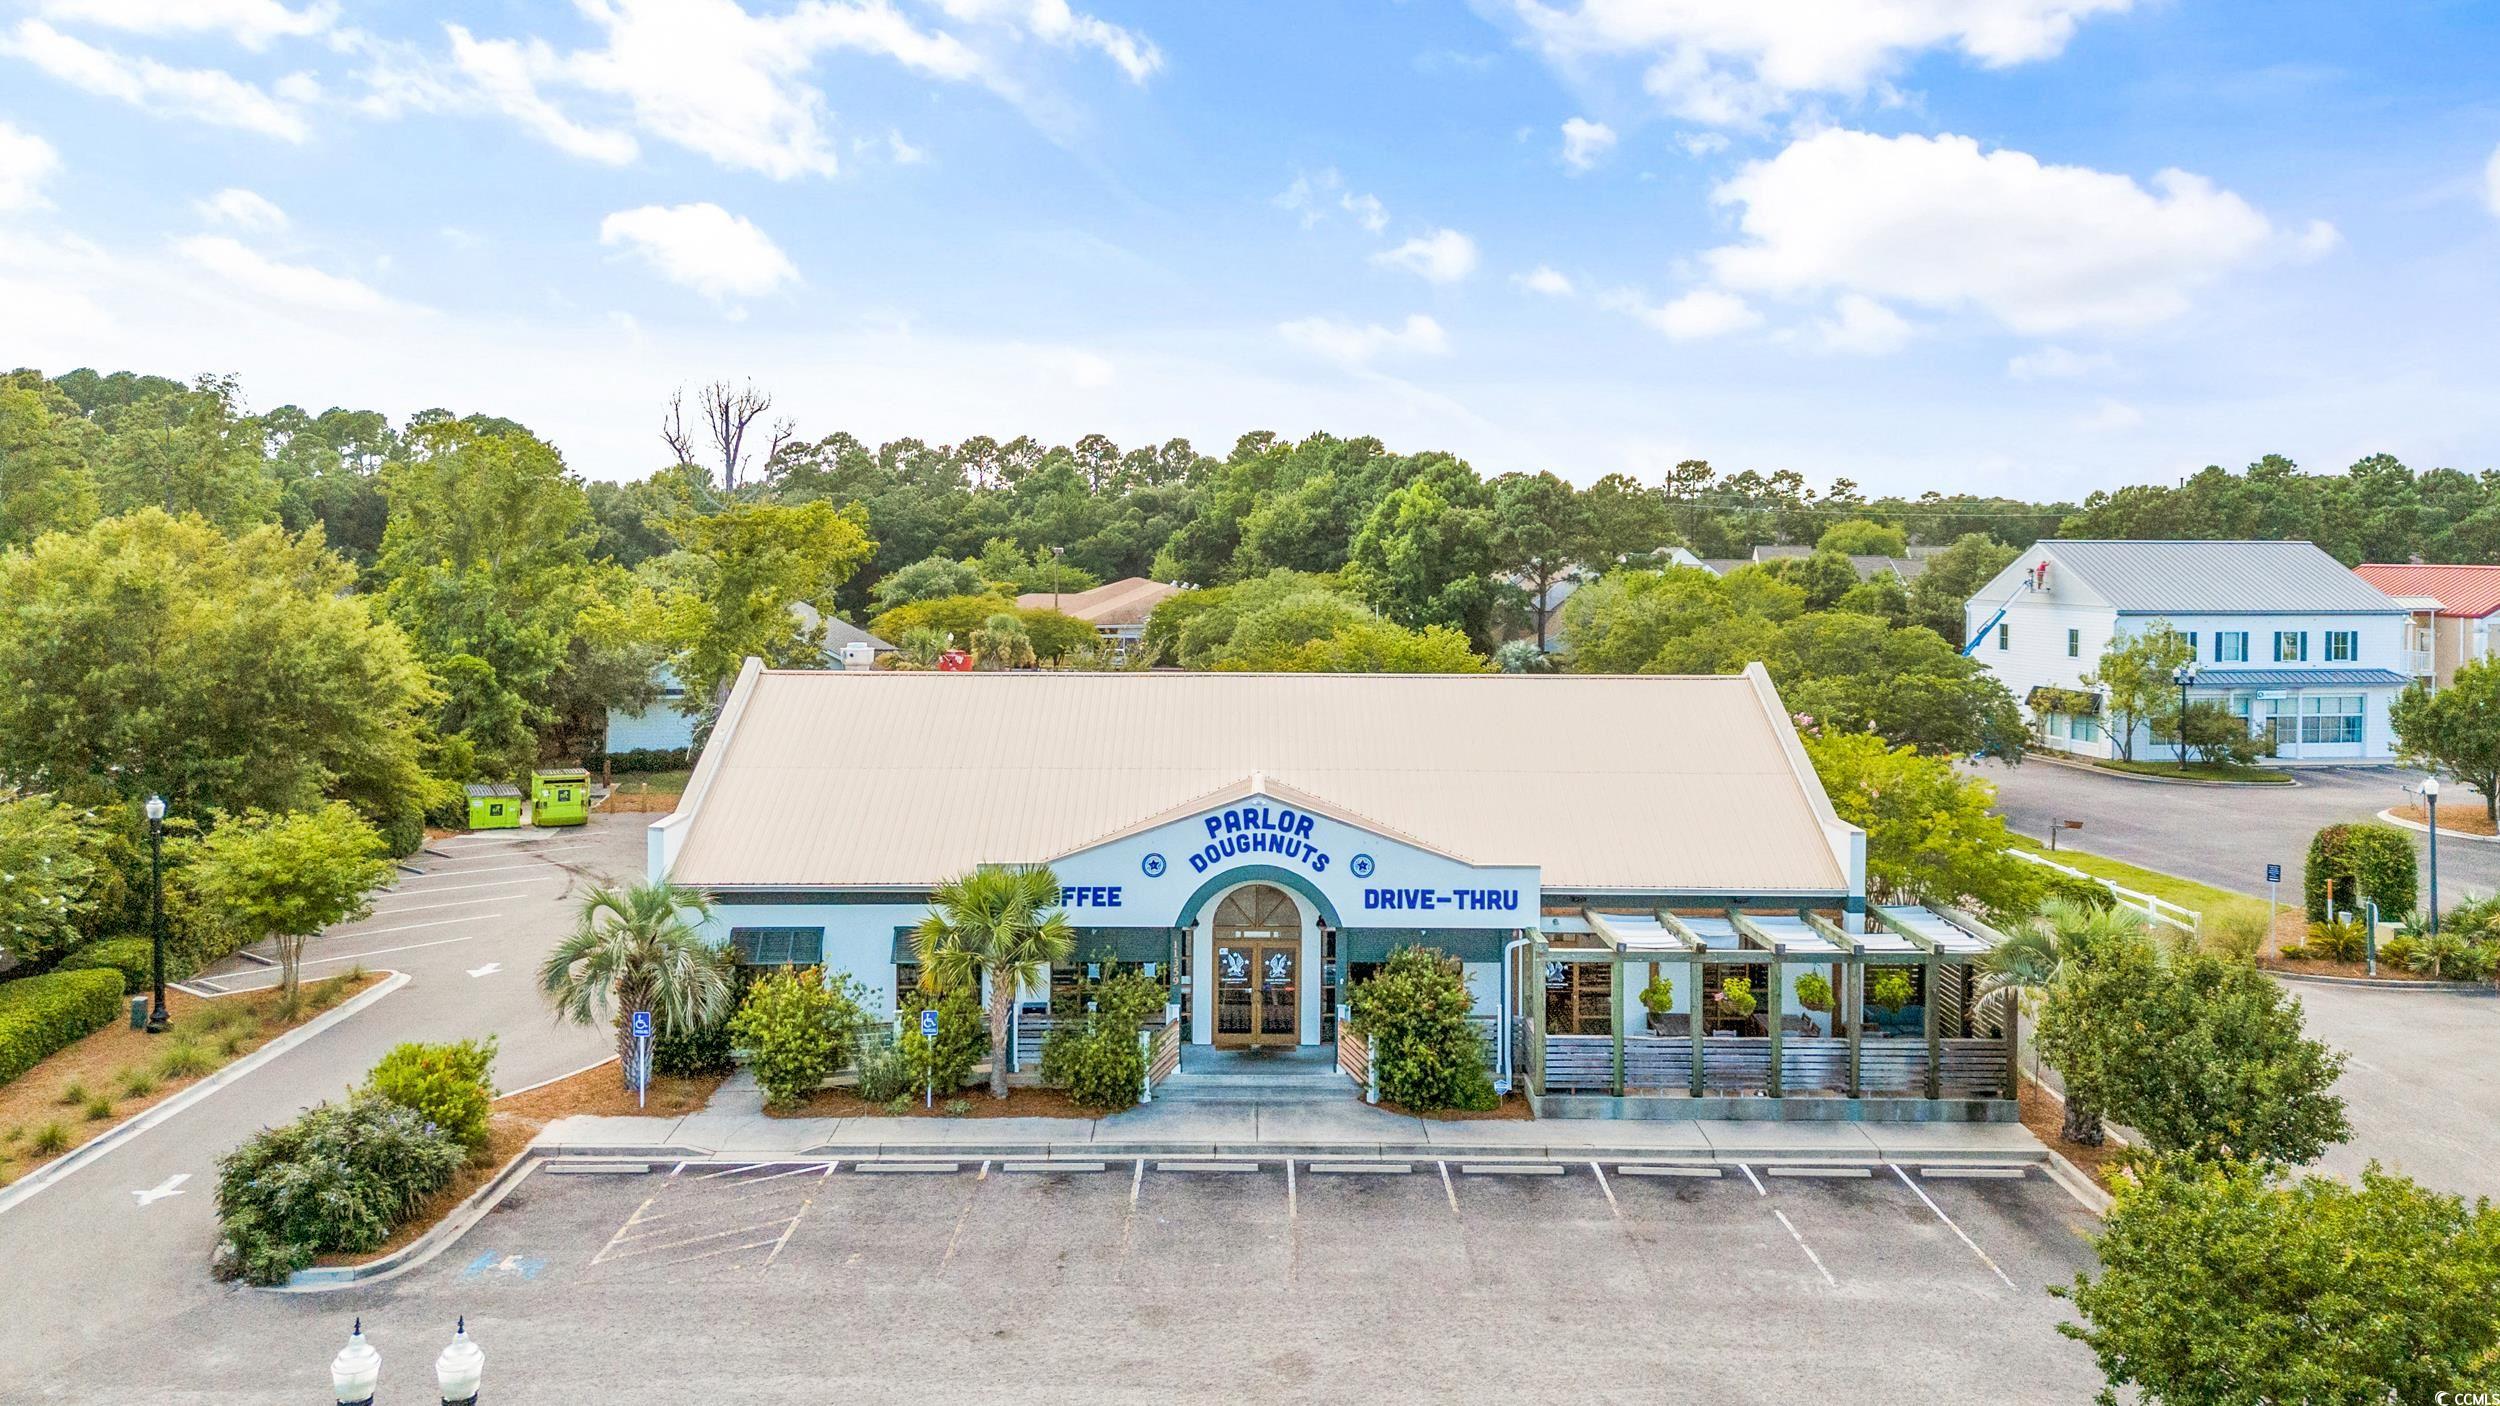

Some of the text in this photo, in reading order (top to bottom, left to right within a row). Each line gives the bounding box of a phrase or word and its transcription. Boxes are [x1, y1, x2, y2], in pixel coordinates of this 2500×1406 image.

[1204, 807, 1315, 840] PARLOR
[1189, 833, 1330, 874] DOUGHNUTS
[1054, 886, 1122, 907] FFEE
[1364, 888, 1519, 911] DRIVE-THRU
[1172, 940, 1180, 985] 11359
